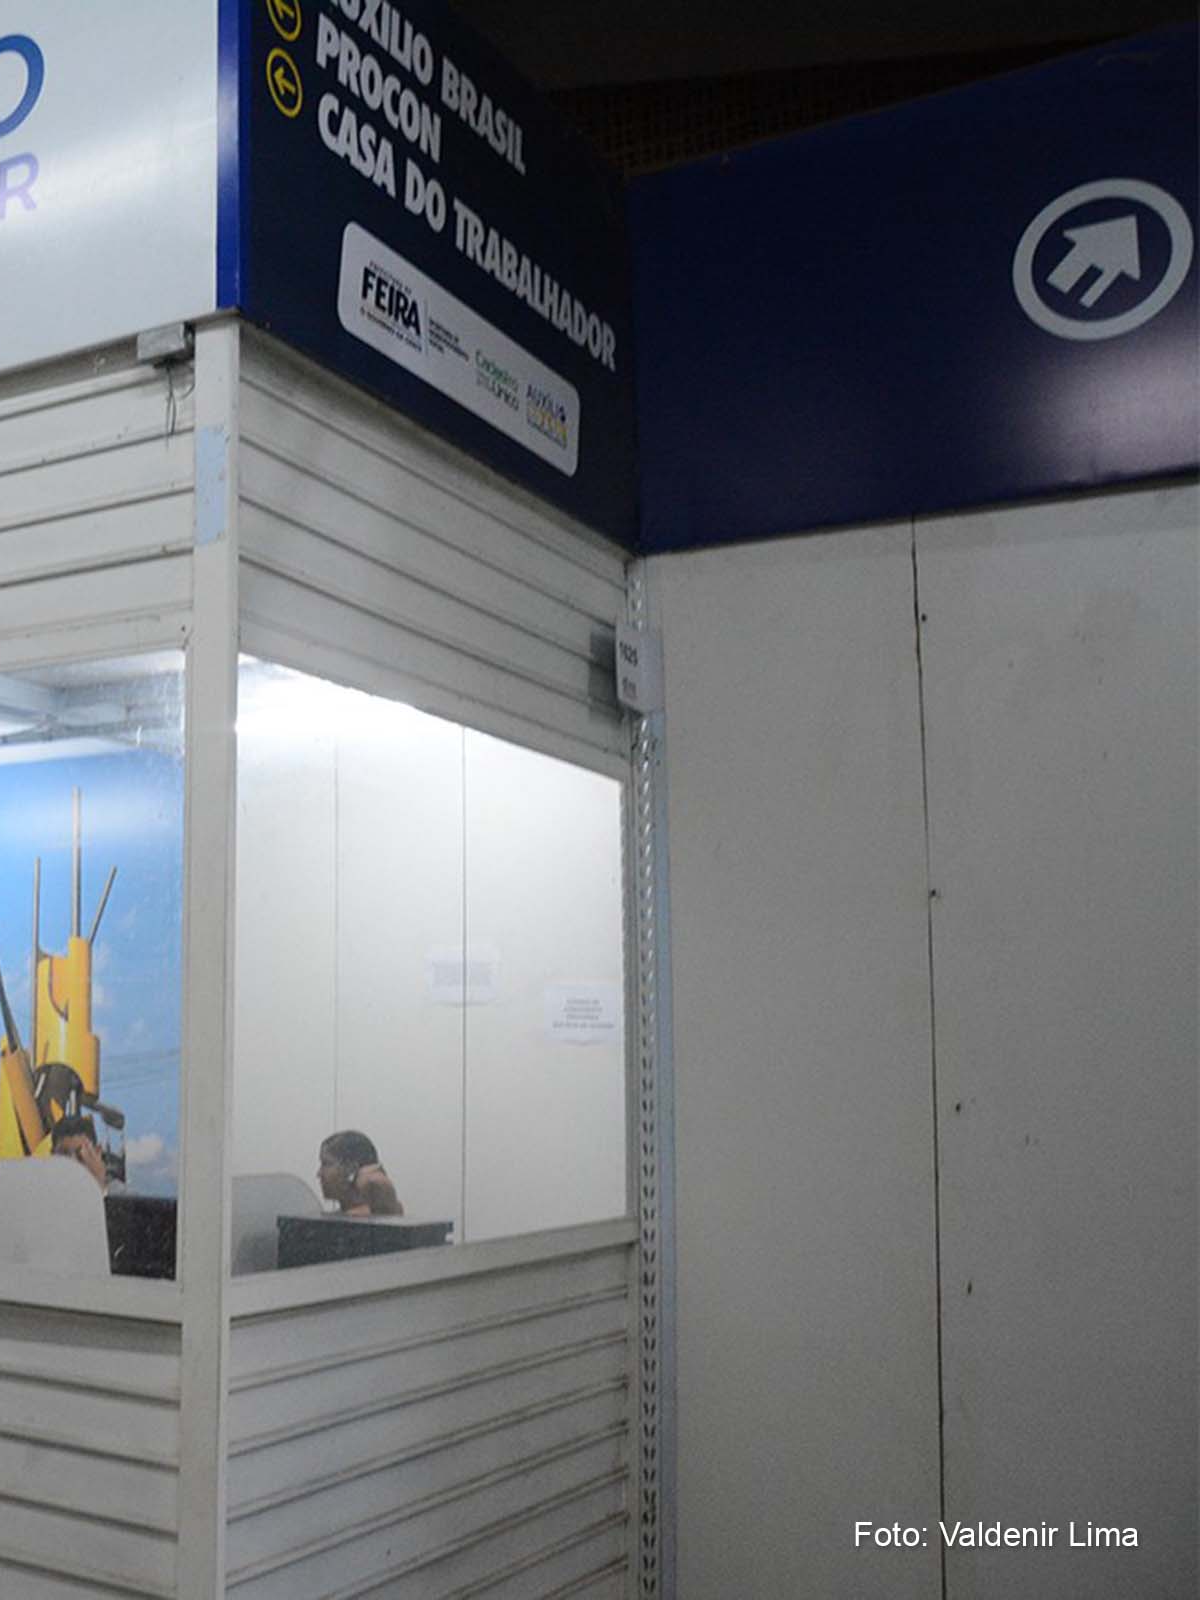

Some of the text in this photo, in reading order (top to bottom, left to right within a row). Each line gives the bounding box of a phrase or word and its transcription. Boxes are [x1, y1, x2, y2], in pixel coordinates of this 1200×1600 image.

[316, 11, 441, 164] PROCON
[330, 0, 526, 177] XILIO BRASIL
[318, 92, 397, 199] CASA
[404, 157, 447, 233] DO
[453, 196, 617, 373] TRABALHADOR
[361, 265, 421, 338] FEIRA
